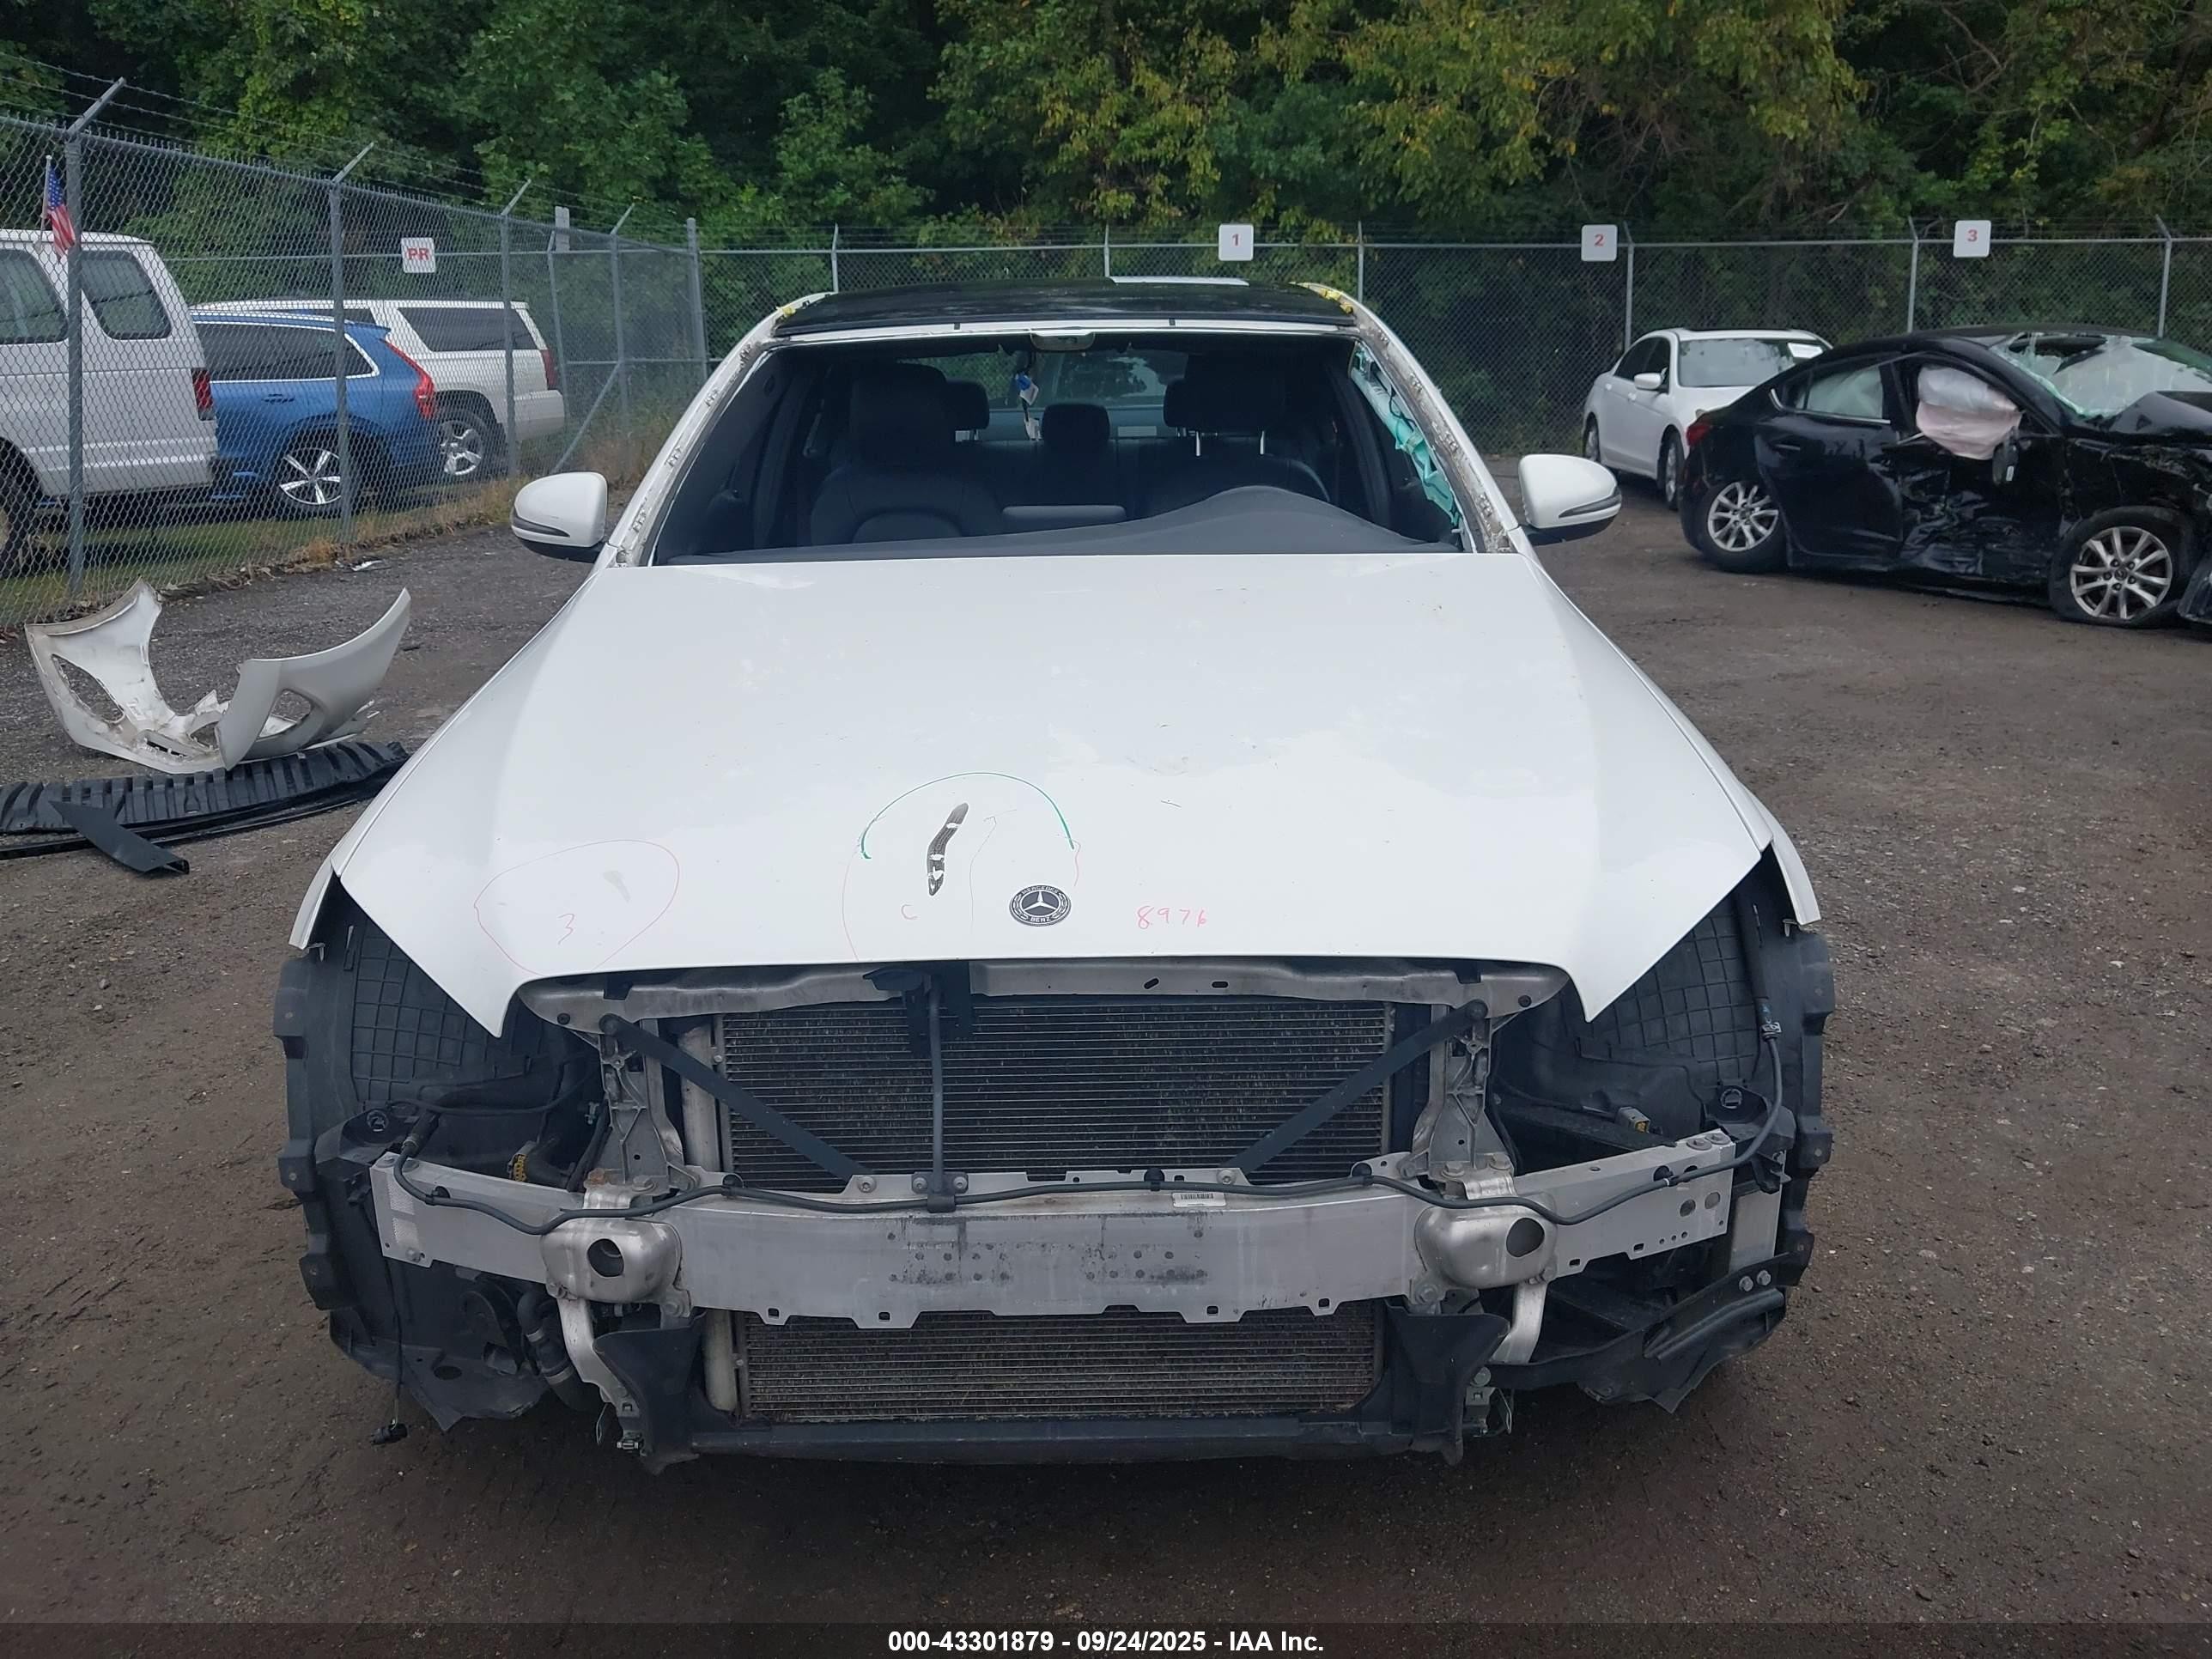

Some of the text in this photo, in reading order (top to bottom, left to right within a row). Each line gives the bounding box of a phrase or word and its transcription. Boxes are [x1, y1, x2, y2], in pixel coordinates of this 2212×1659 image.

[1231, 233, 1239, 246] 1
[1594, 234, 1604, 247] 2
[1967, 229, 1978, 242] 3
[407, 247, 429, 261] PR
[1137, 905, 1207, 930] 8976
[556, 913, 575, 945] 3
